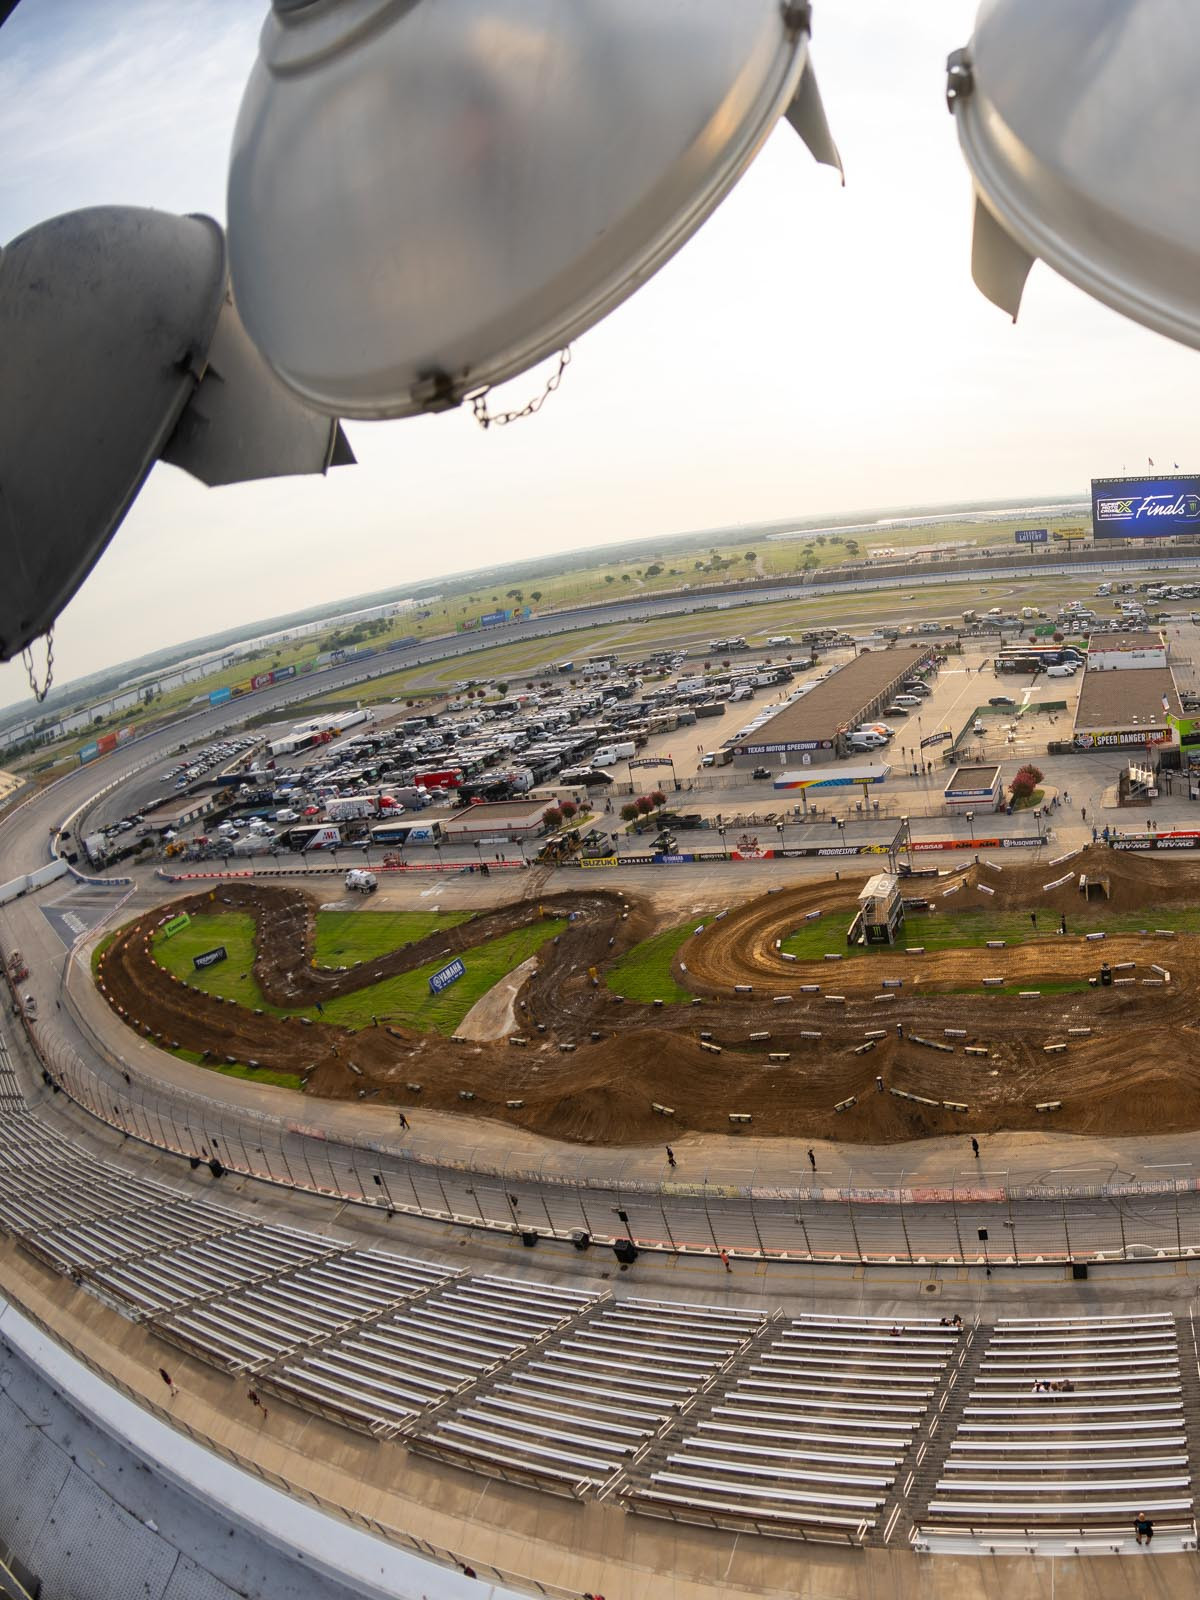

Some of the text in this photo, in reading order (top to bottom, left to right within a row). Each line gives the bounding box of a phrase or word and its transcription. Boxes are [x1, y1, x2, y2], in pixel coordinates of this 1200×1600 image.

[1135, 494, 1186, 518] Finals
[1097, 735, 1118, 745] SPEED
[1120, 733, 1146, 744] DANGER
[747, 742, 818, 754] TEXAS MOTOR SPEEDWAY
[1009, 839, 1042, 847] Husqvarna
[817, 847, 858, 855] PROGRESSIVE
[583, 858, 617, 867] SUZUKI
[195, 952, 219, 966] TRIUMPH
[438, 961, 463, 983] YAMAHA
[439, 971, 463, 989] RACING
